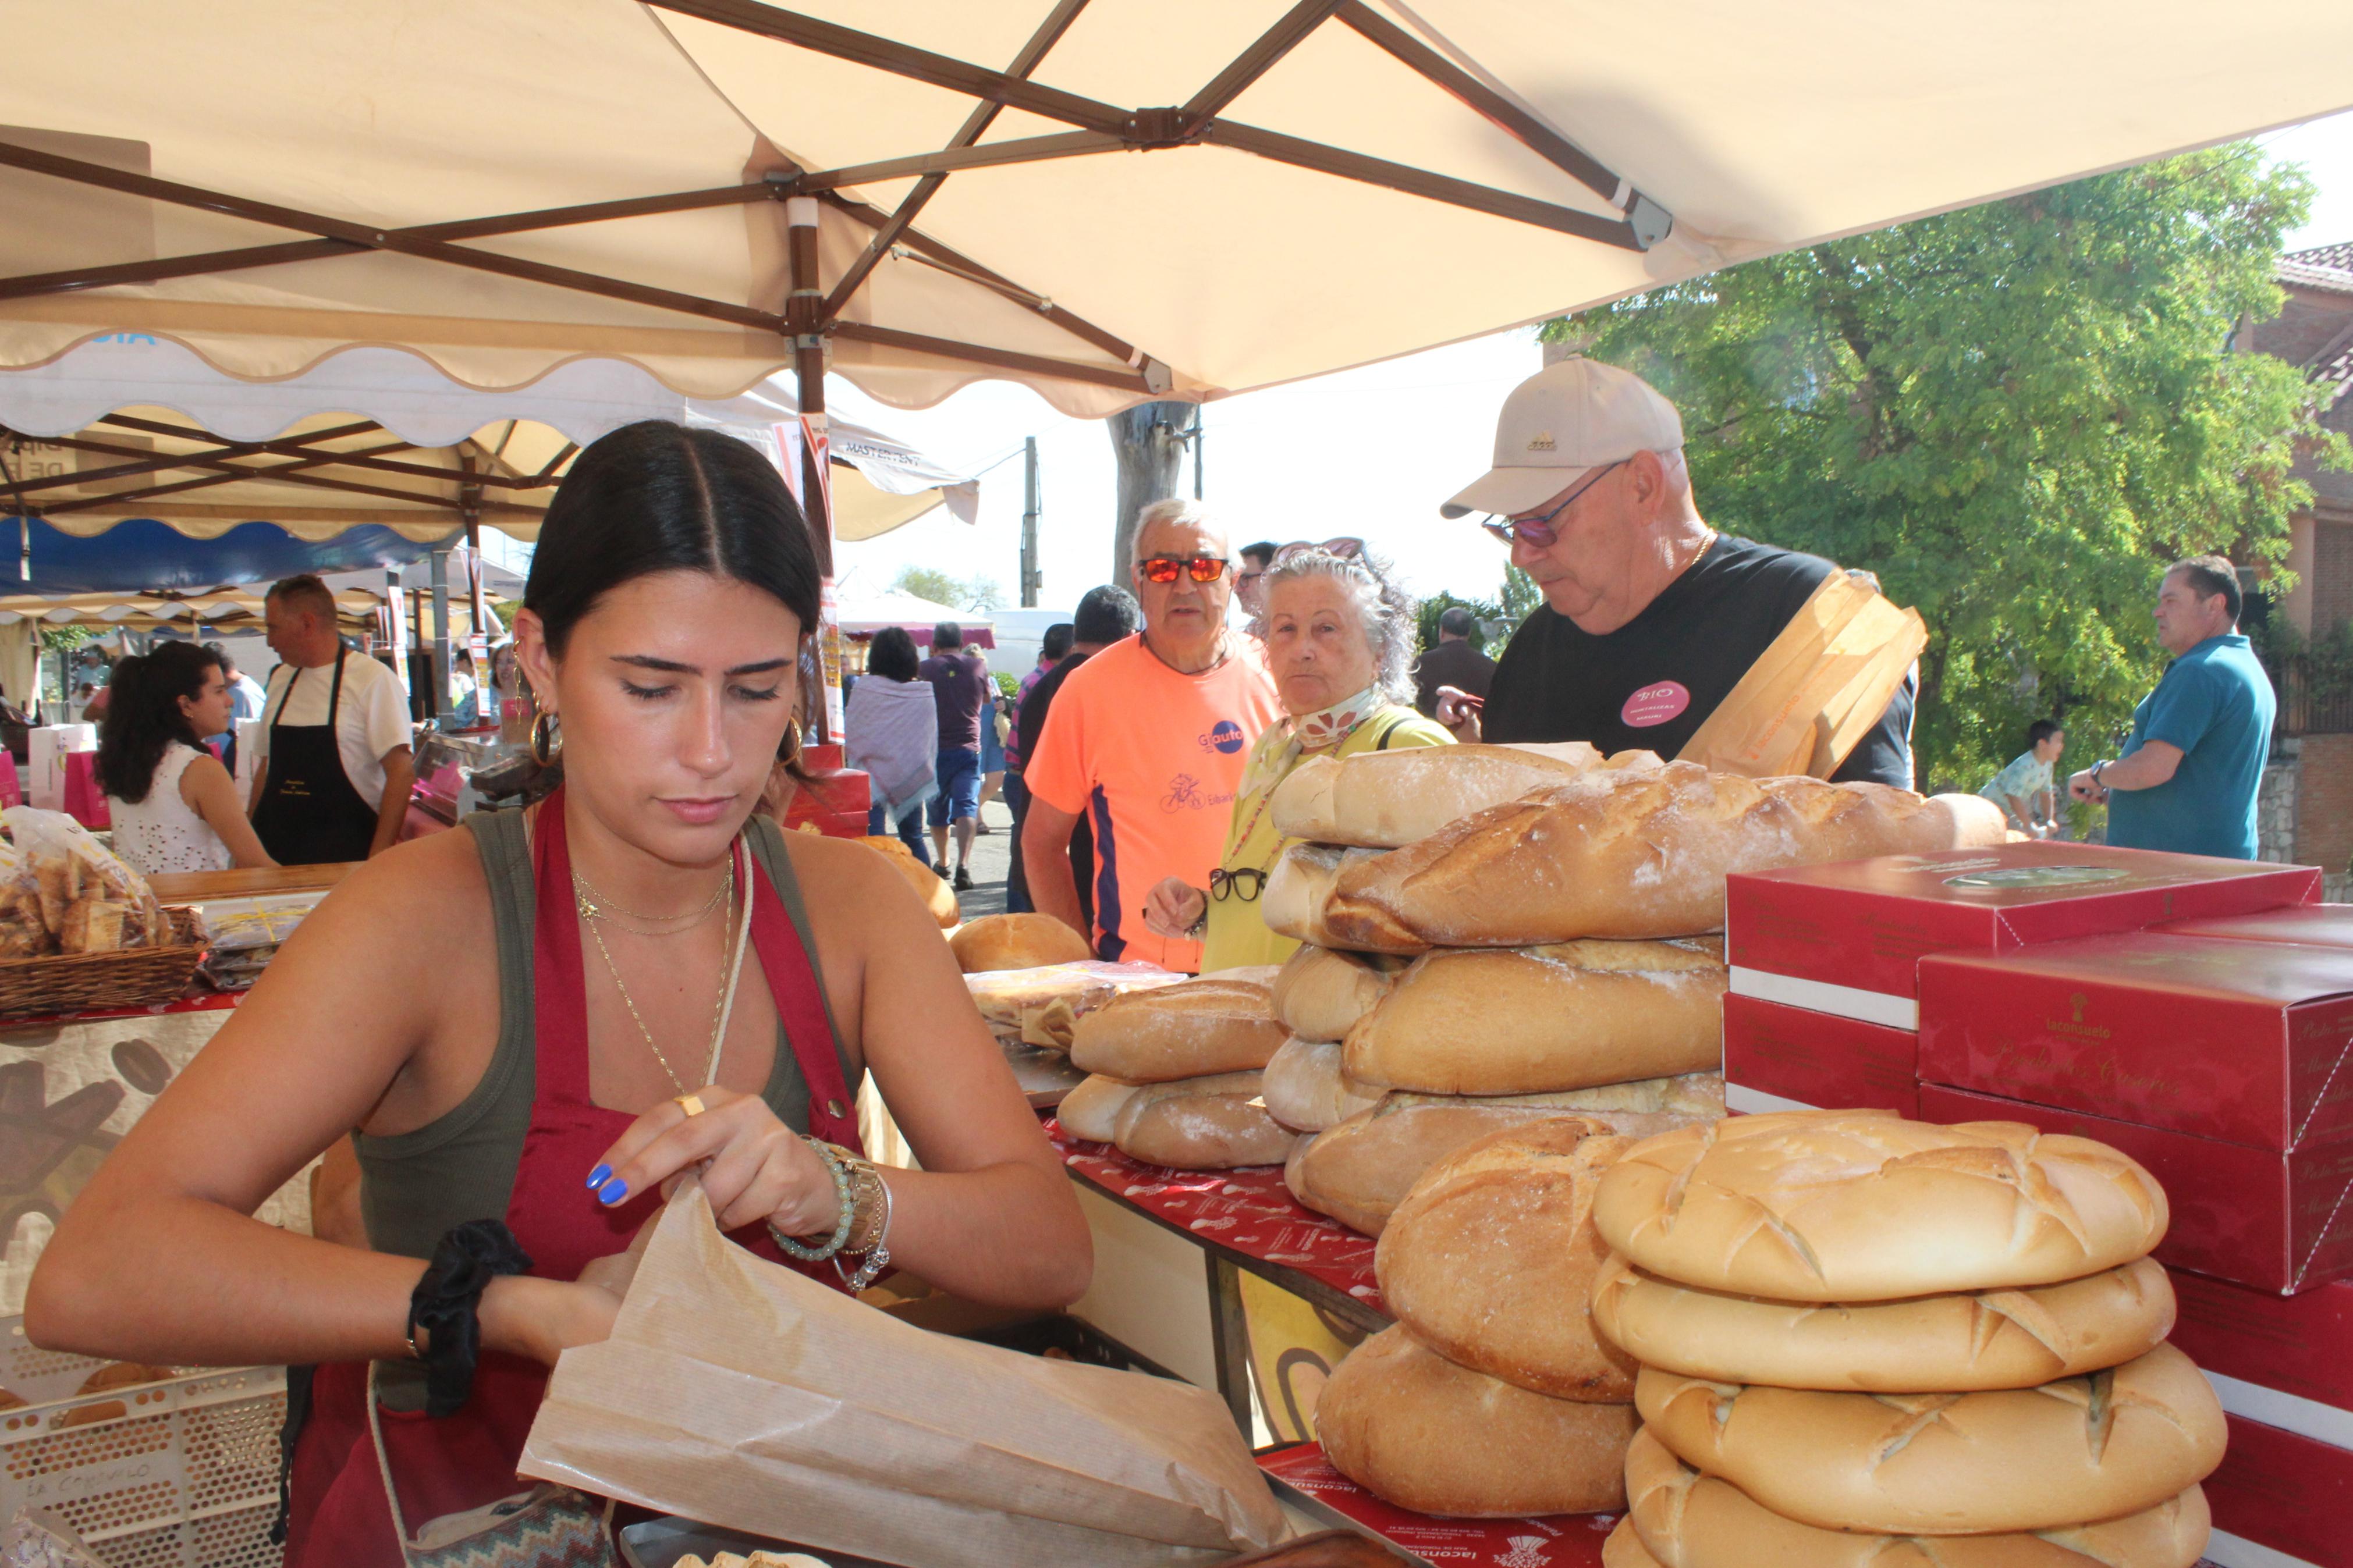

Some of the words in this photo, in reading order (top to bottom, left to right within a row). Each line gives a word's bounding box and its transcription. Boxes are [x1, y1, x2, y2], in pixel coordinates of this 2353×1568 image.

[846, 442, 921, 466] MASTERTENT
[1637, 688, 1673, 701] BIO
[2046, 1017, 2111, 1039] laconsuelo
[1289, 1481, 1357, 1493] laconsue
[1409, 1550, 1477, 1560] laconsu
